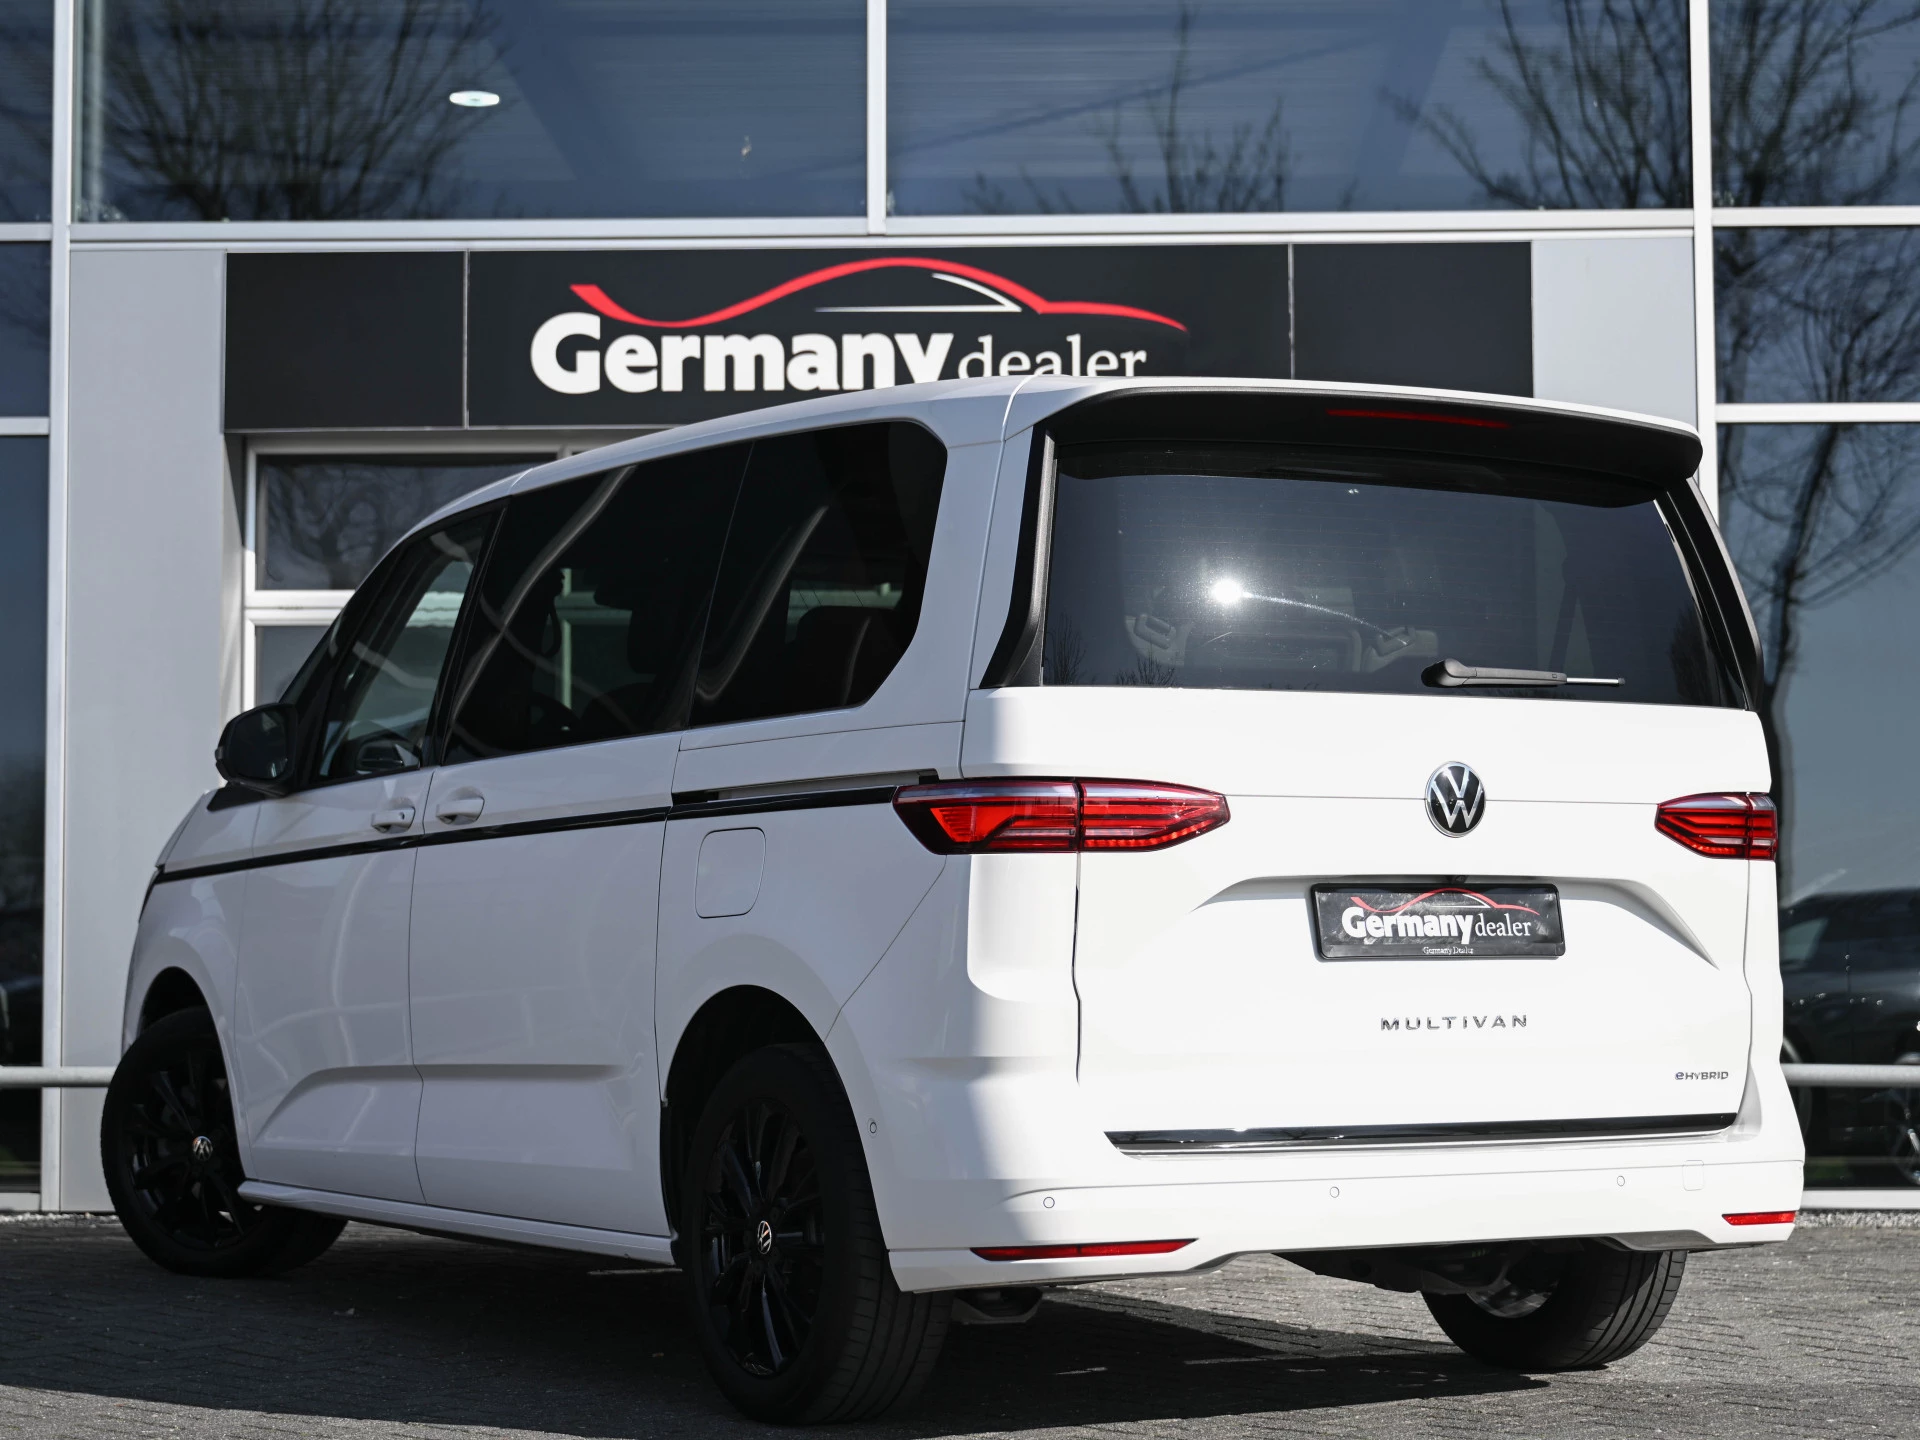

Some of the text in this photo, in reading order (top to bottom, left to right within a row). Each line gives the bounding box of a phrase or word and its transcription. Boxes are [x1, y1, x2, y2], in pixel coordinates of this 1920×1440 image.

[530, 311, 1147, 394] Germany dealer
[1341, 906, 1532, 945] Germany dealer
[1422, 946, 1452, 956] Germany
[1380, 1014, 1528, 1032] MULTIVAN
